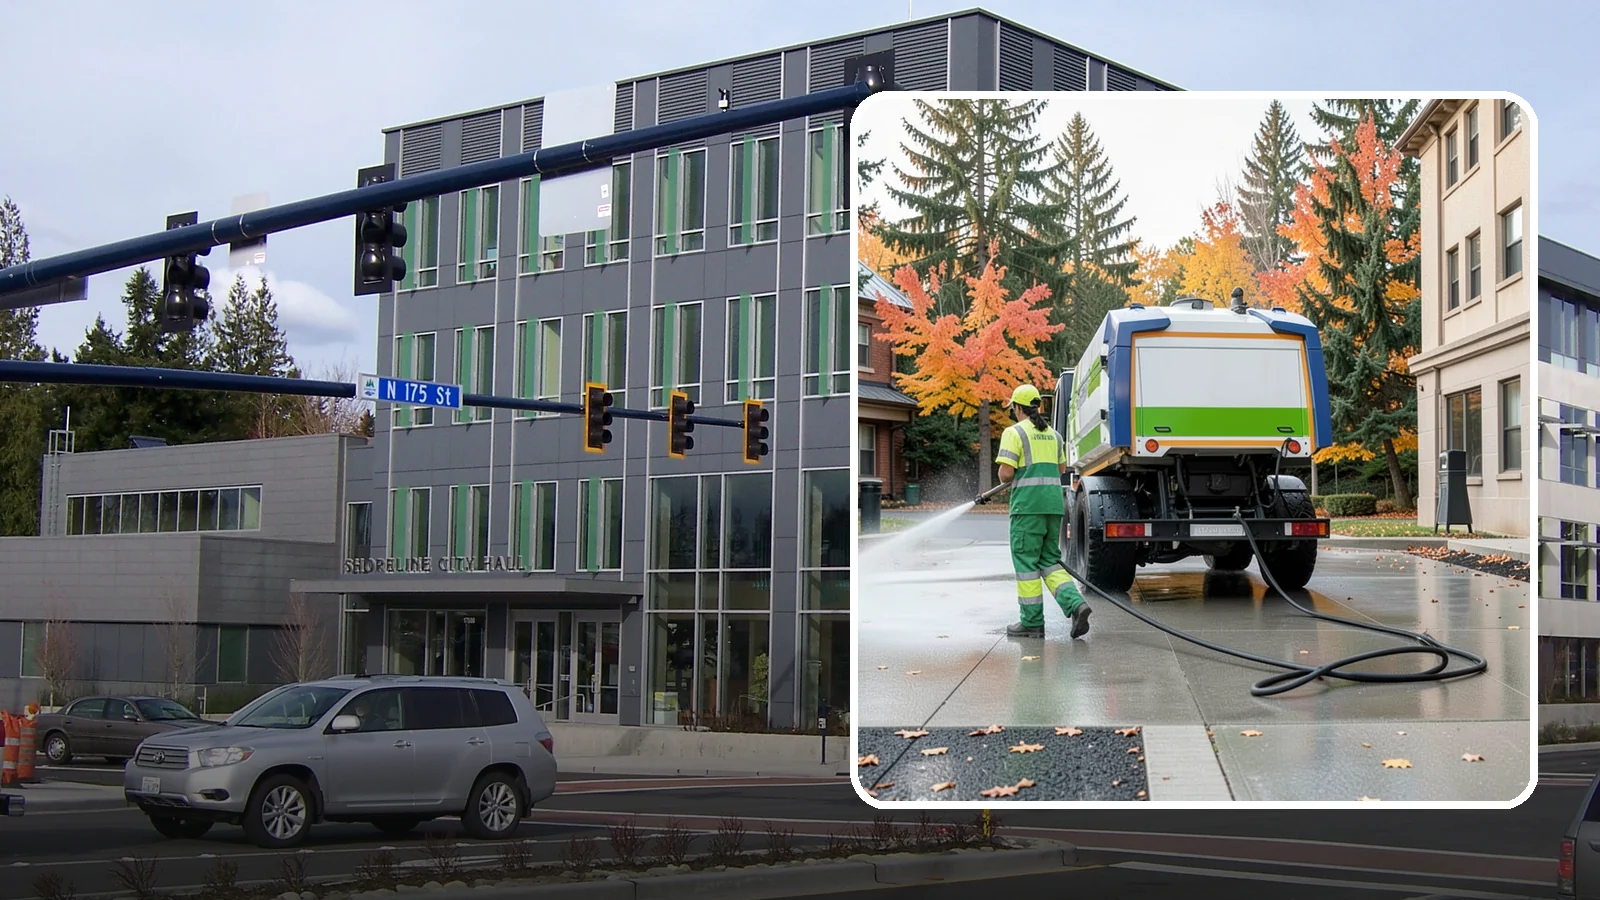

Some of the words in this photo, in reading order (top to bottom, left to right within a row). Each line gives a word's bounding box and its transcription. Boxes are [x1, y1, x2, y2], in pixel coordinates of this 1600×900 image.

[387, 380, 396, 400] N
[405, 382, 427, 403] 175
[436, 386, 451, 405] St
[344, 557, 432, 574] SHORELINE
[438, 555, 476, 572] CITY
[484, 555, 525, 572] HALL
